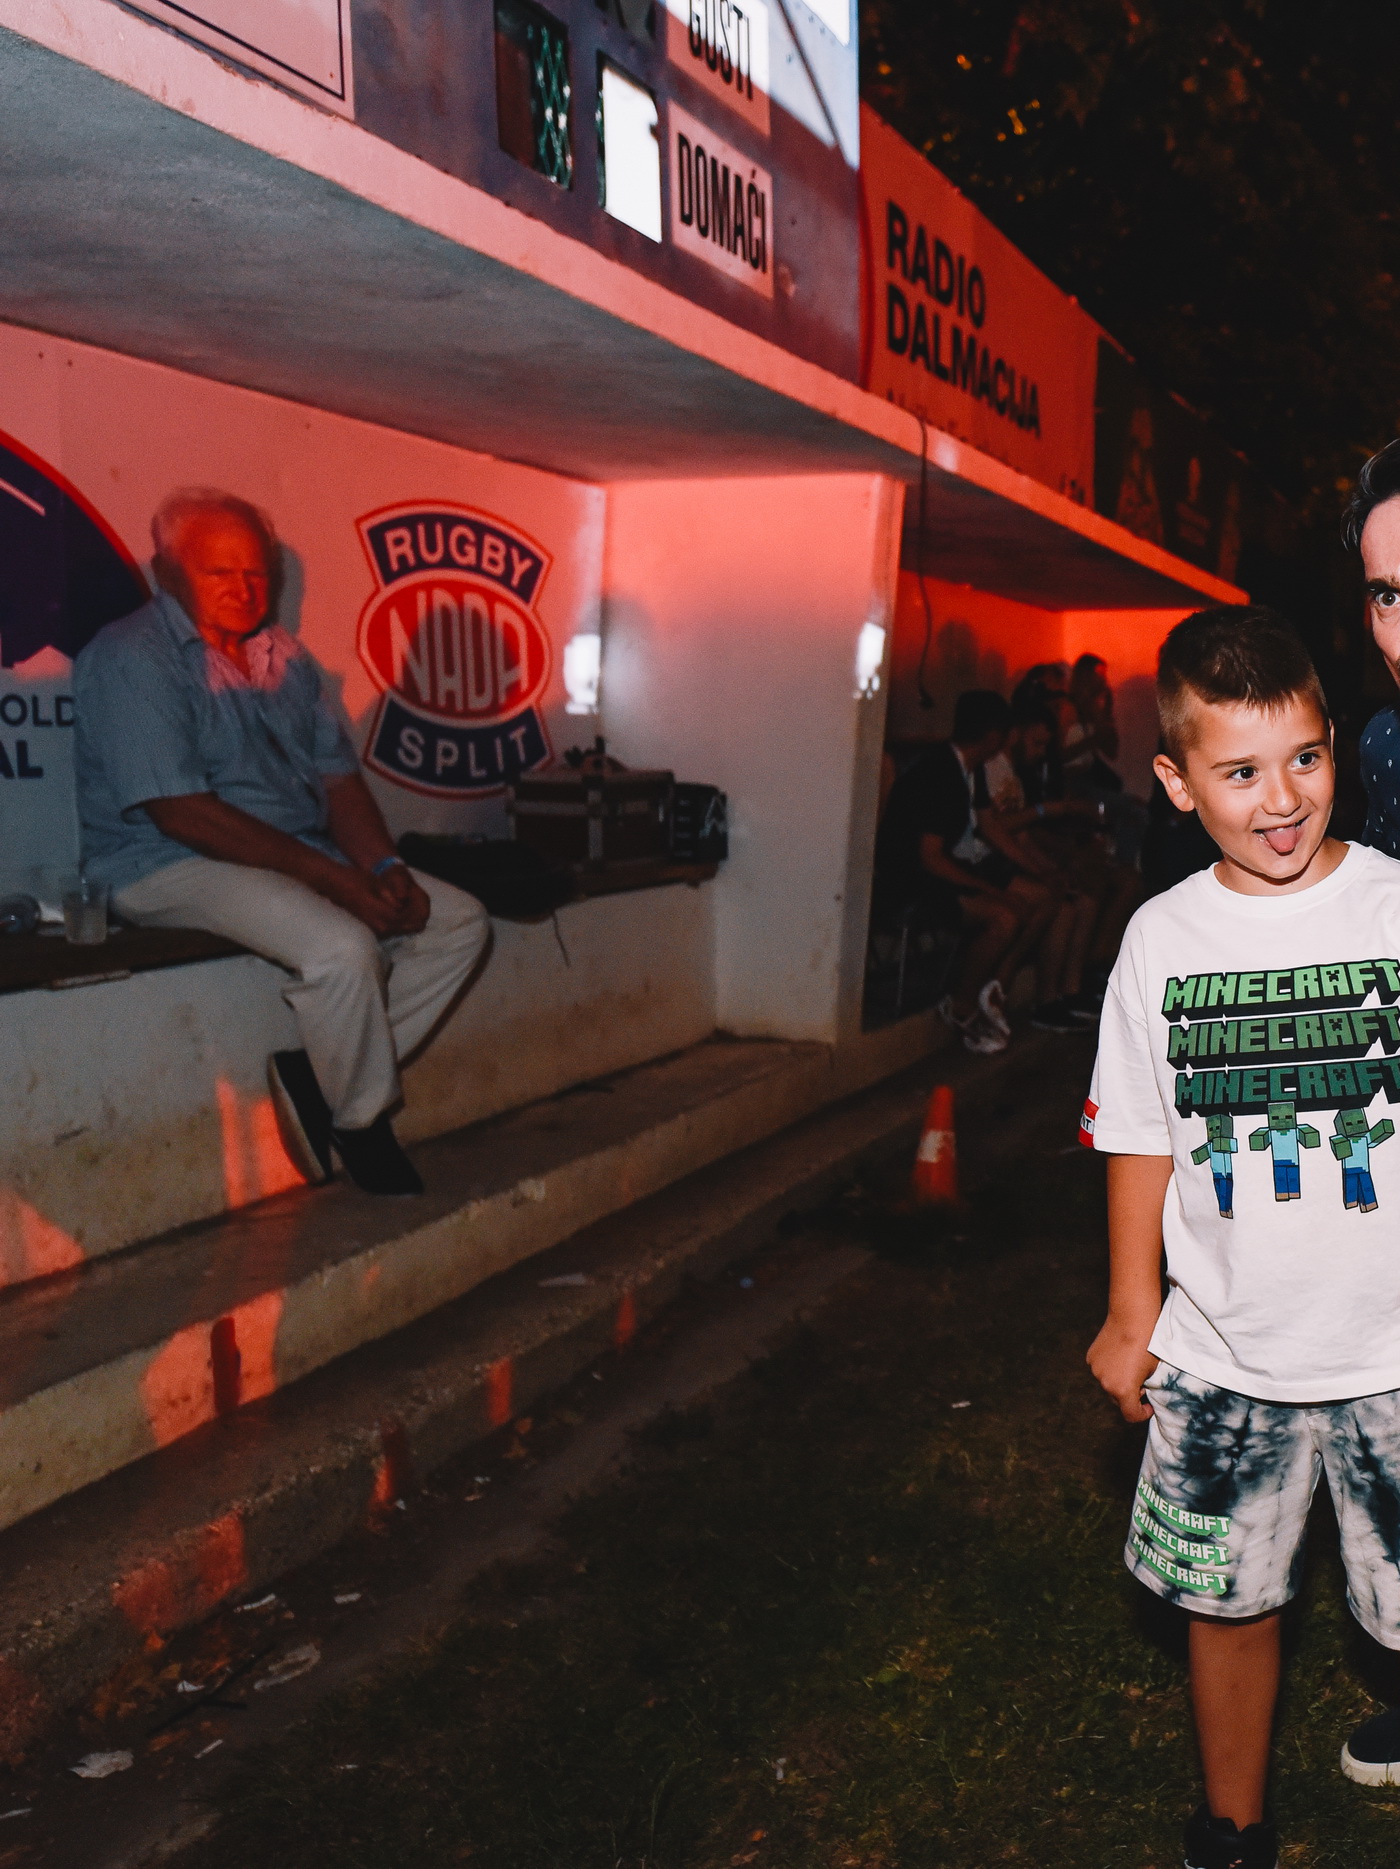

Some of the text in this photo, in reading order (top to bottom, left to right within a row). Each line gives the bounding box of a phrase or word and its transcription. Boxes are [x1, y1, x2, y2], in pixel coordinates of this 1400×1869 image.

[678, 132, 768, 273] DOMAĆI
[887, 199, 986, 329] RADIO
[887, 281, 1041, 440] DALMACIJA
[384, 521, 535, 588] RUGBY
[389, 587, 529, 712] NADA
[398, 726, 528, 778] SPLIT
[1134, 1505, 1228, 1565] MINECRAFT
[1138, 1476, 1230, 1536] MINECRAFT
[1132, 1533, 1227, 1593] MINECRAFT
